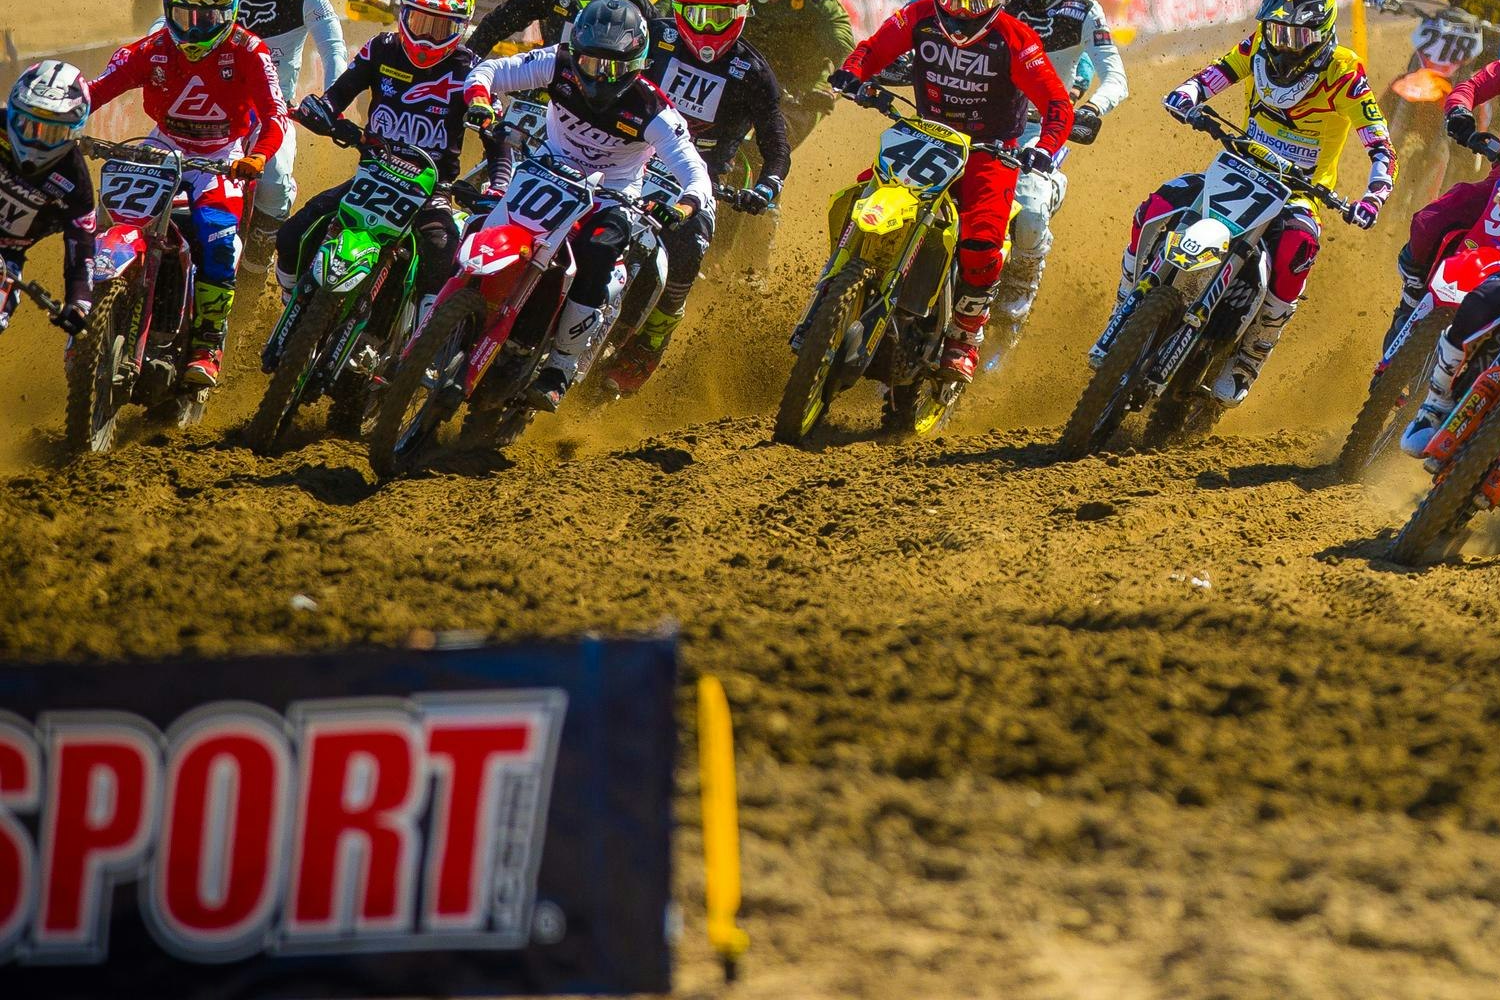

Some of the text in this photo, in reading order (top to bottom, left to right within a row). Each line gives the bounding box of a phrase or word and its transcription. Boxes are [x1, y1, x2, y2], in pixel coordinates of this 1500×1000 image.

[1416, 26, 1478, 63] 218
[669, 66, 720, 107] FLY
[926, 71, 989, 93] SUZUKI
[943, 93, 988, 105] TOYOTA
[911, 129, 934, 144] LUCAS
[1255, 130, 1319, 159] Husqvarna
[117, 164, 162, 178] LUCAS OIL
[378, 170, 401, 187] LUCAS
[535, 167, 570, 190] LUCAS OIL
[883, 136, 960, 190] 46
[1257, 174, 1270, 188] OIL
[343, 177, 414, 228] 929
[507, 177, 580, 231] 101
[1209, 172, 1276, 229] 21
[1101, 296, 1136, 345] DUNLOP
[1388, 312, 1419, 356] DUNLOP
[1159, 326, 1195, 380] DUNLOP
